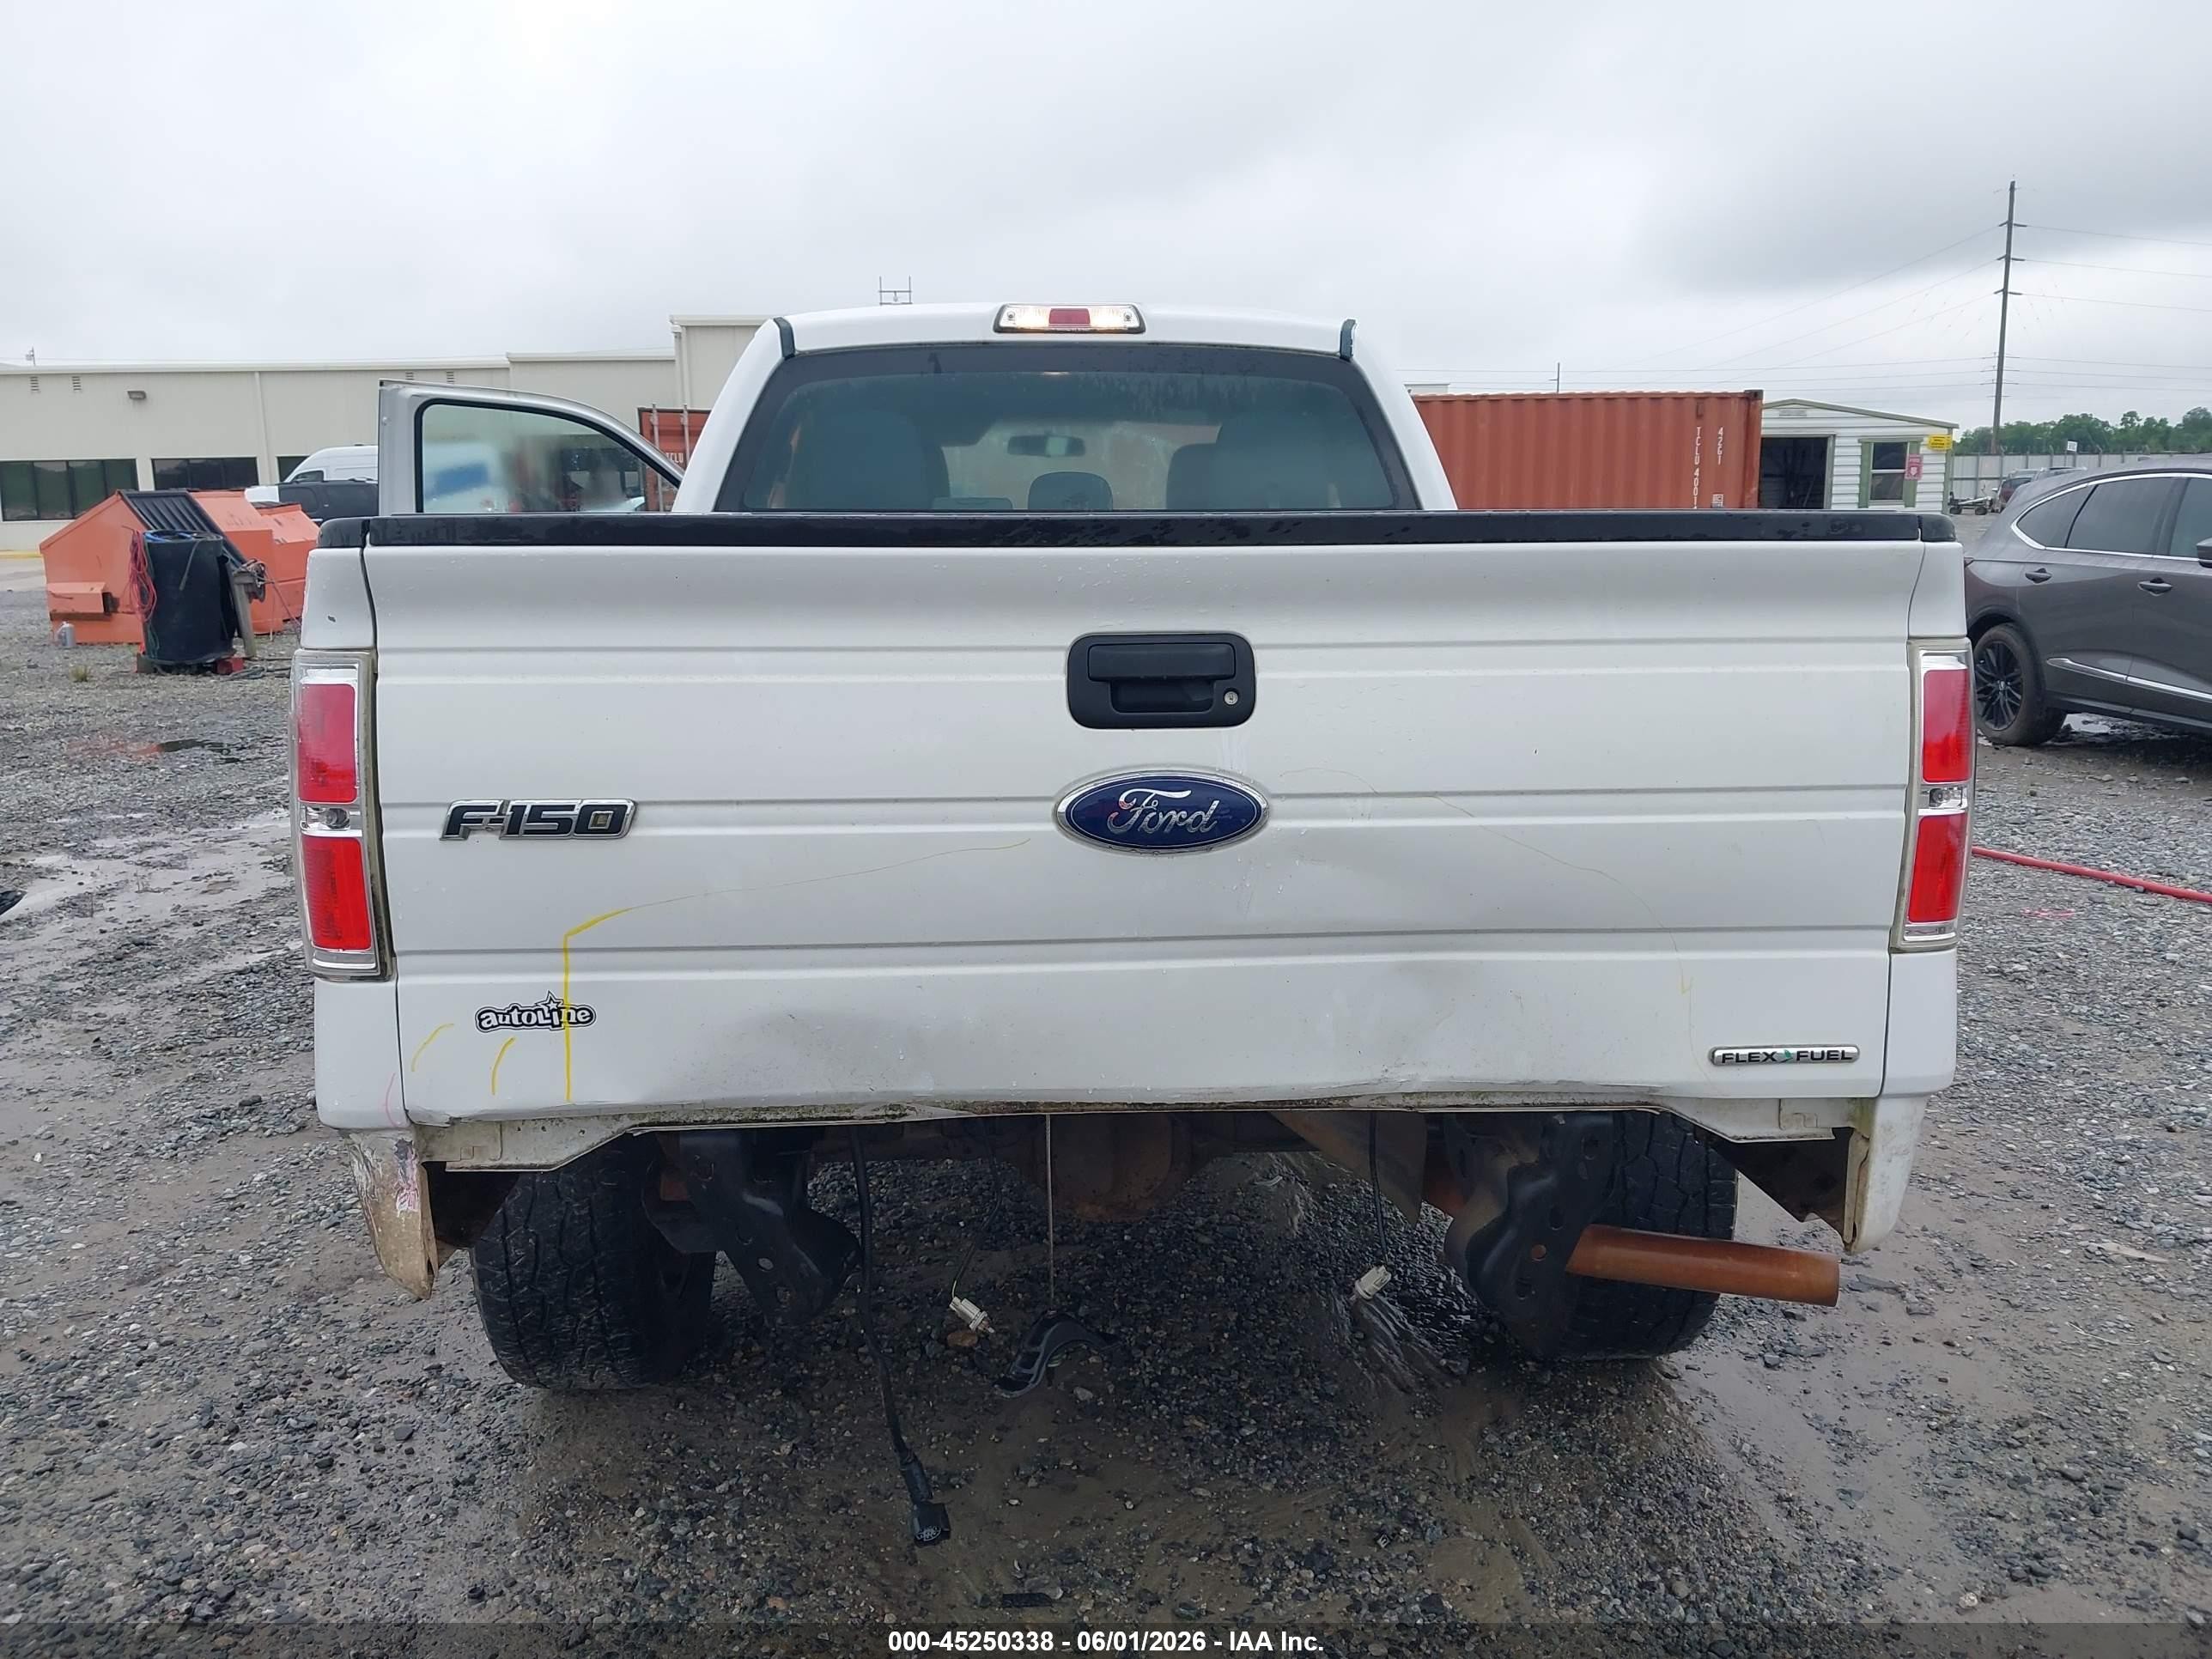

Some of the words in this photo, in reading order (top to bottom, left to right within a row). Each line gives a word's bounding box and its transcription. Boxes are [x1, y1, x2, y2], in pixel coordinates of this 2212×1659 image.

[440, 799, 638, 841] F-150
[1107, 787, 1218, 835] Ford
[1721, 1050, 1779, 1064] FLEX
[1796, 1049, 1856, 1061] FUEL
